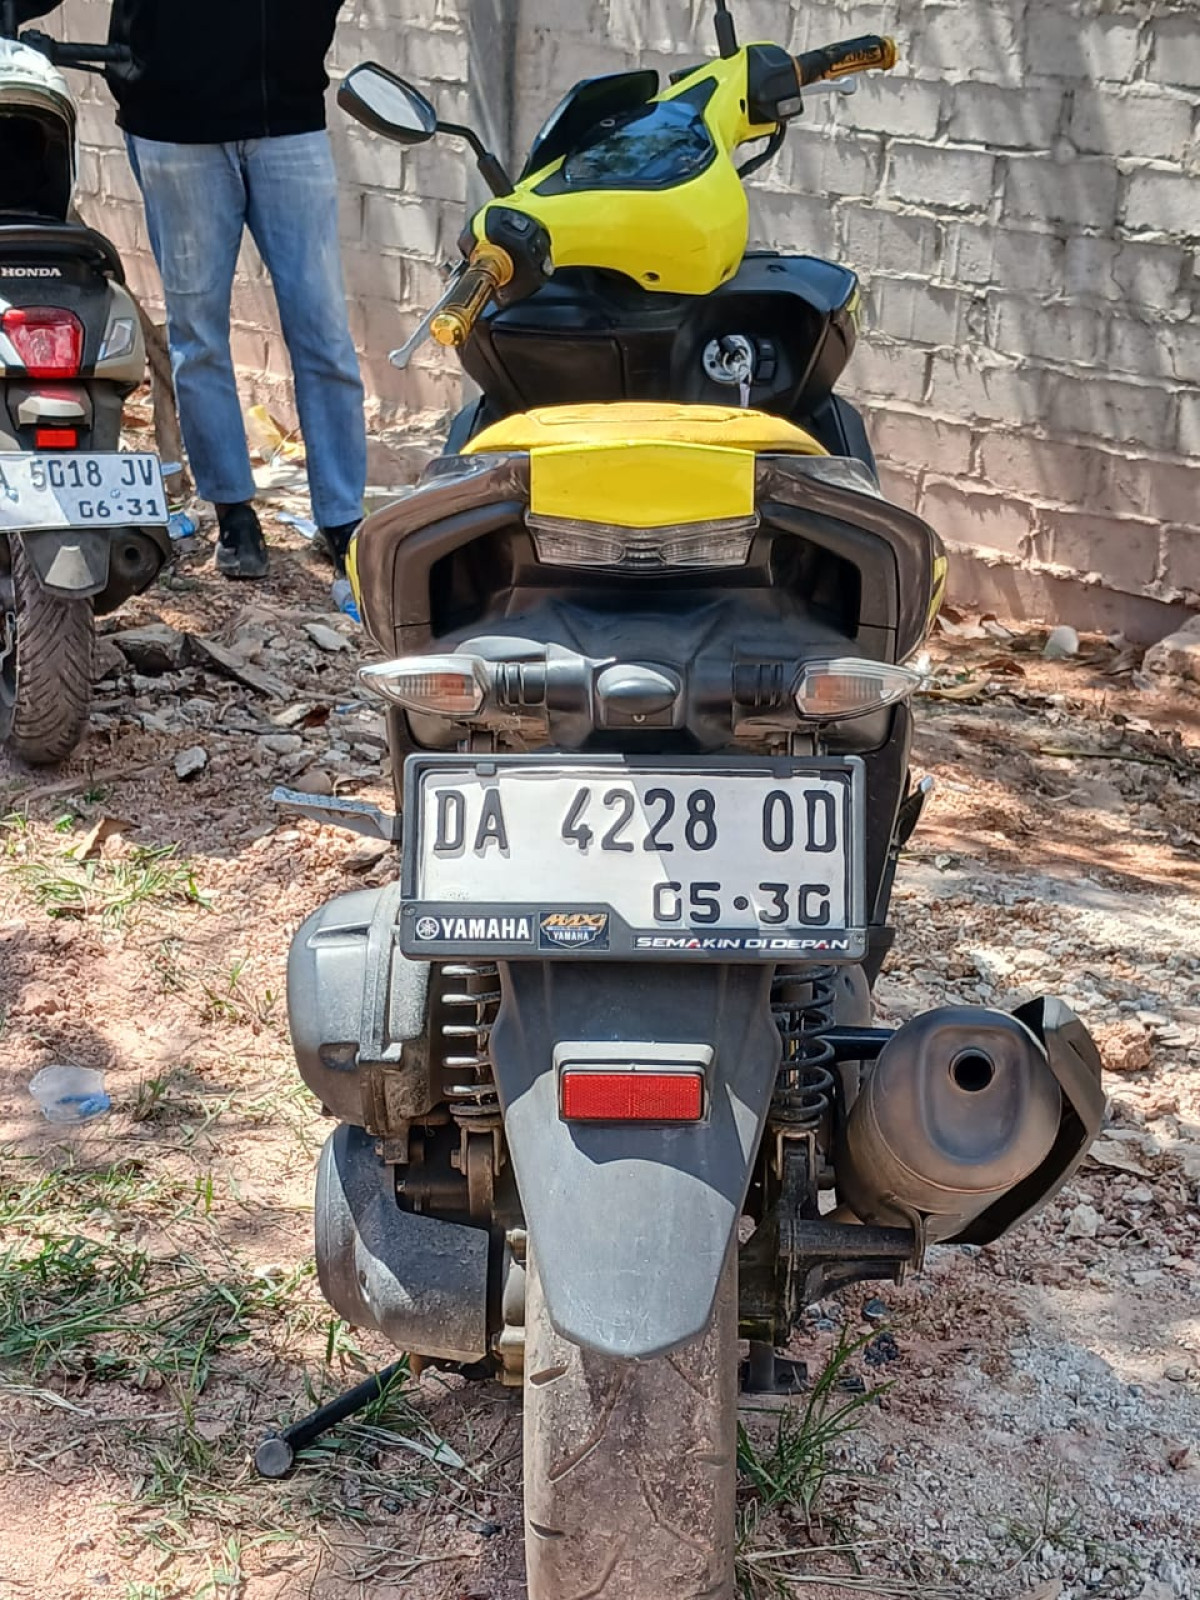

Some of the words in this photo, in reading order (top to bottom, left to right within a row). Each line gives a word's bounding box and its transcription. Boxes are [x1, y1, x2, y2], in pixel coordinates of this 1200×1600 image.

[1, 268, 62, 277] HONDA
[30, 460, 103, 488] 5018
[121, 459, 154, 486] JV
[434, 789, 508, 852] DA
[561, 788, 717, 852] 4228
[442, 918, 530, 940] YAMAHA
[553, 931, 590, 941] YAMAHA
[636, 936, 742, 949] SEMAKIN
[744, 938, 768, 949] DI
[770, 938, 849, 950] DEPAN
